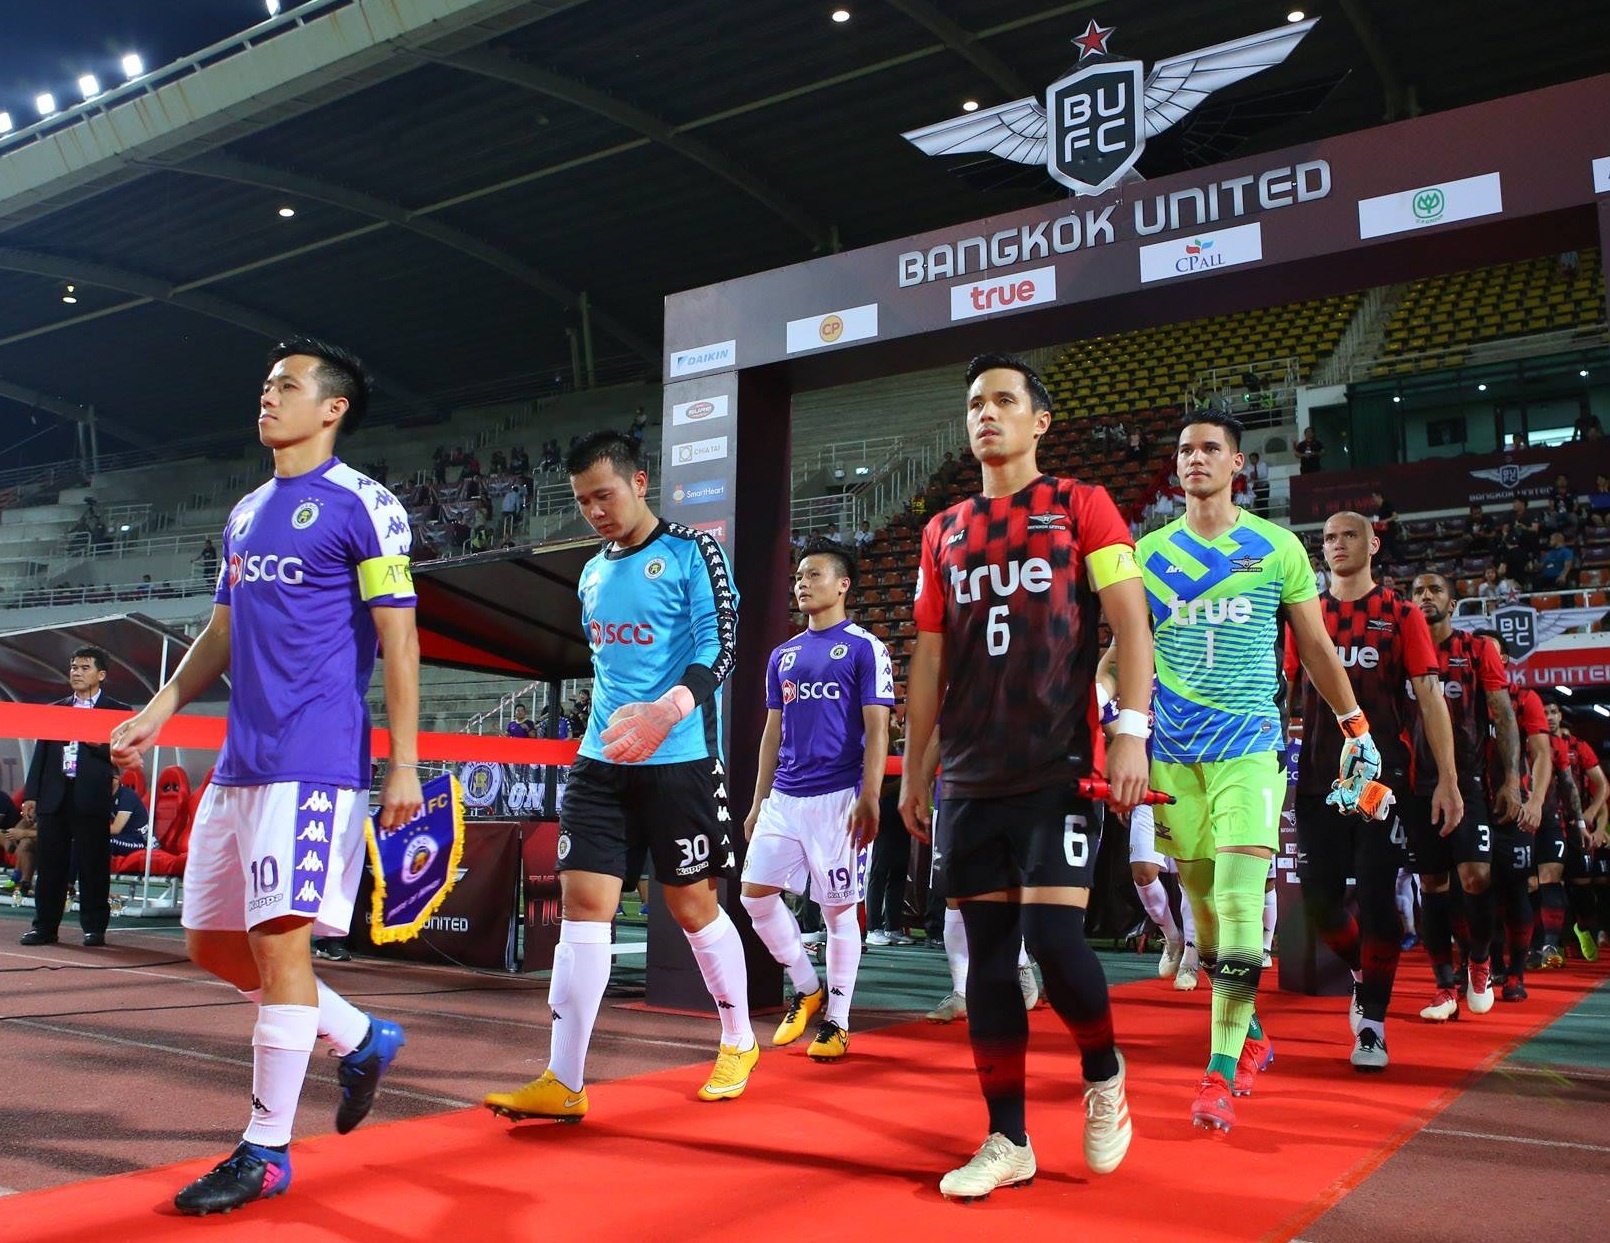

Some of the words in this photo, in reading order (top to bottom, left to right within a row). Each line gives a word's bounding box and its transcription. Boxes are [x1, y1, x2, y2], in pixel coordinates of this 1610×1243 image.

[1063, 82, 1126, 128] BU
[1064, 117, 1126, 163] FC
[899, 204, 1118, 289] BANGKOK
[1134, 158, 1332, 237] UNITED
[969, 279, 1036, 311] true
[822, 321, 841, 337] CP
[687, 349, 730, 366] DAIKIN
[686, 486, 725, 499] SmartHeart
[245, 554, 304, 585] SCG
[949, 557, 1053, 604] true
[1168, 594, 1253, 626] true
[1500, 616, 1529, 632] BU
[605, 623, 654, 645] SCG
[986, 604, 1011, 657] 6
[1205, 630, 1215, 668] 1
[1336, 645, 1380, 669] ue
[1534, 664, 1610, 685] UNITE
[799, 681, 840, 700] SCG
[428, 793, 449, 815] FC
[1262, 788, 1273, 828] 1
[1063, 814, 1089, 868] 6
[1389, 815, 1408, 850] 4
[1477, 824, 1491, 852] 3
[675, 833, 710, 868] 30
[1513, 845, 1532, 869] 31
[1554, 840, 1565, 858] 7
[250, 855, 279, 900] 10
[675, 860, 710, 876] Kappa
[827, 867, 851, 892] 19
